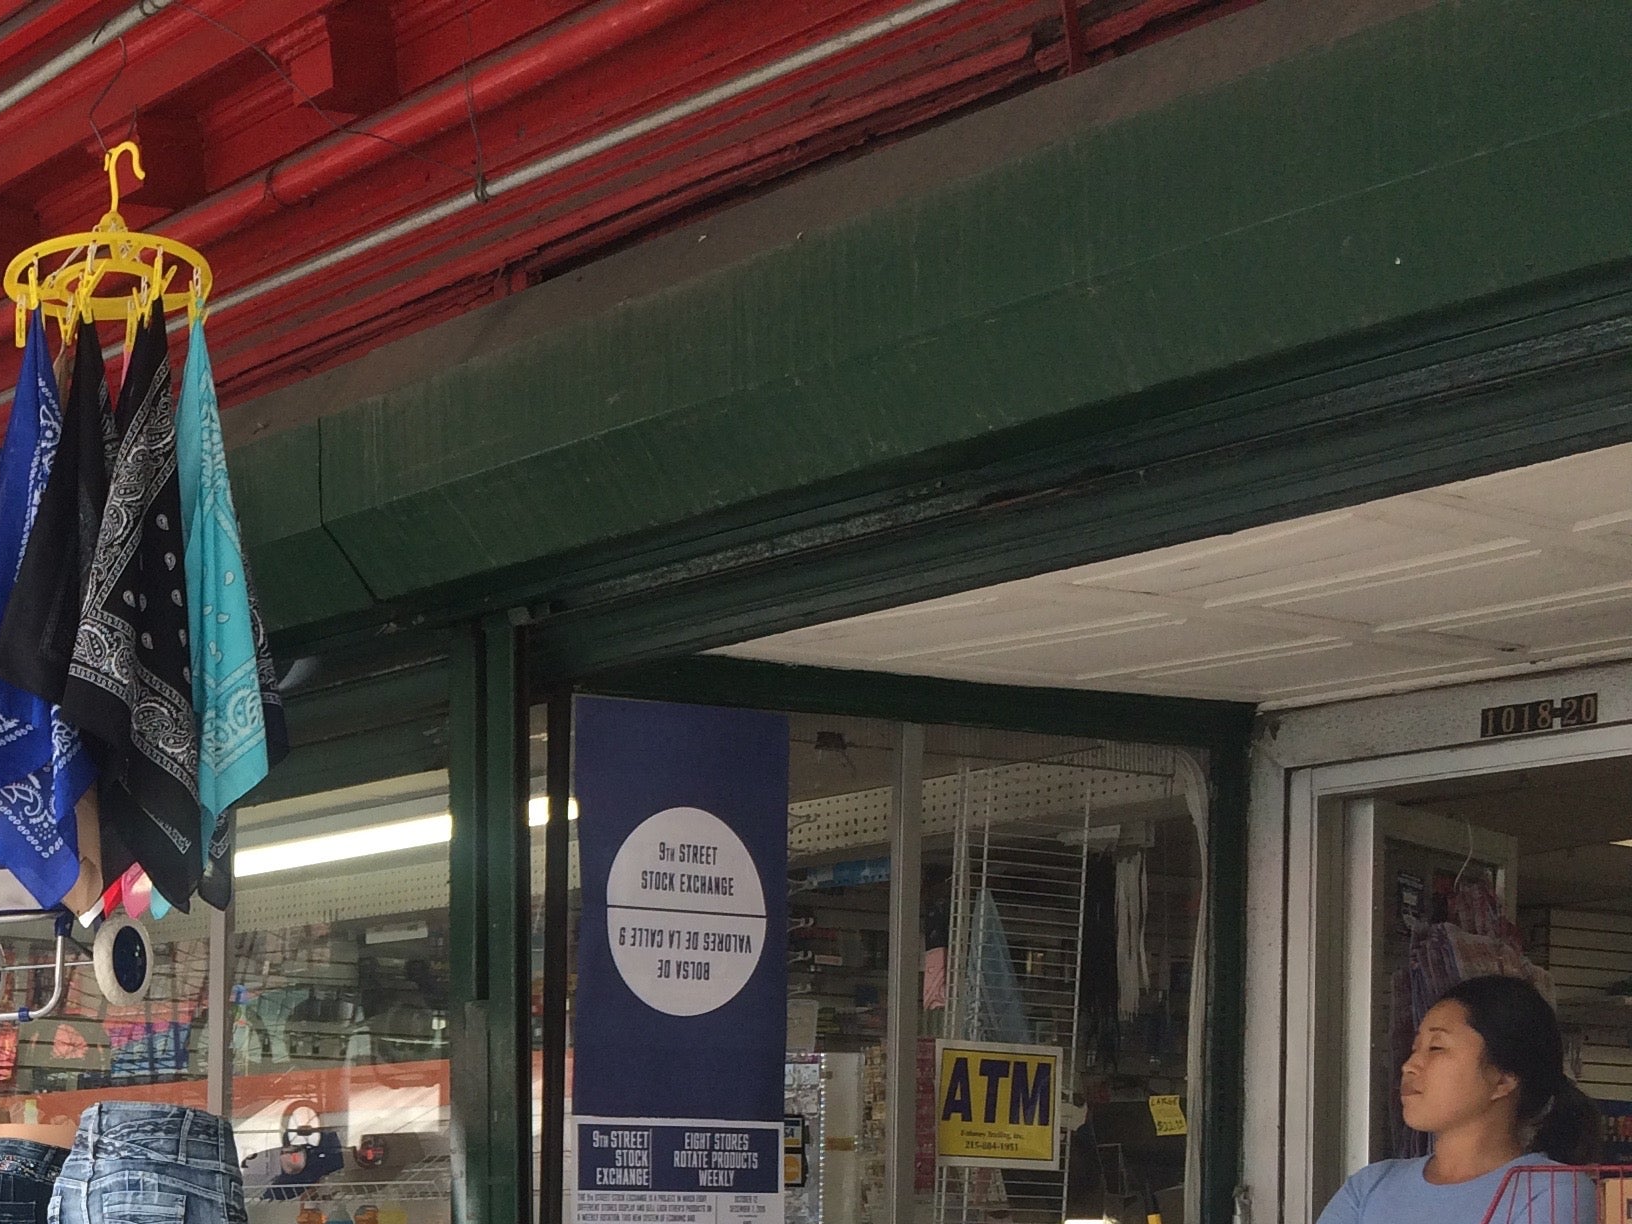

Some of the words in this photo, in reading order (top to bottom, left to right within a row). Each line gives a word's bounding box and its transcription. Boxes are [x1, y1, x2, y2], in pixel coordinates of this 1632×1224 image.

[1486, 696, 1596, 736] 1018-20
[678, 843, 718, 866] STREET
[641, 870, 676, 892] STOCK
[679, 873, 735, 897] EXCHANGE
[618, 926, 626, 946] 9
[630, 928, 664, 949] CALLE
[668, 930, 681, 949] LA
[685, 931, 699, 951] DE
[703, 932, 753, 954] VALORES
[657, 959, 671, 979] DE
[675, 960, 711, 981] BOLSA
[941, 1056, 1052, 1127] ATM
[610, 1130, 649, 1149] STREET
[684, 1132, 711, 1150] EIGHT
[713, 1133, 750, 1151] STORES
[615, 1149, 649, 1168] STOCK
[673, 1150, 709, 1169] ROTATE
[711, 1151, 759, 1170] PRODUCTS
[596, 1167, 649, 1187] EXCHANGE
[698, 1169, 735, 1187] WEEKLY
